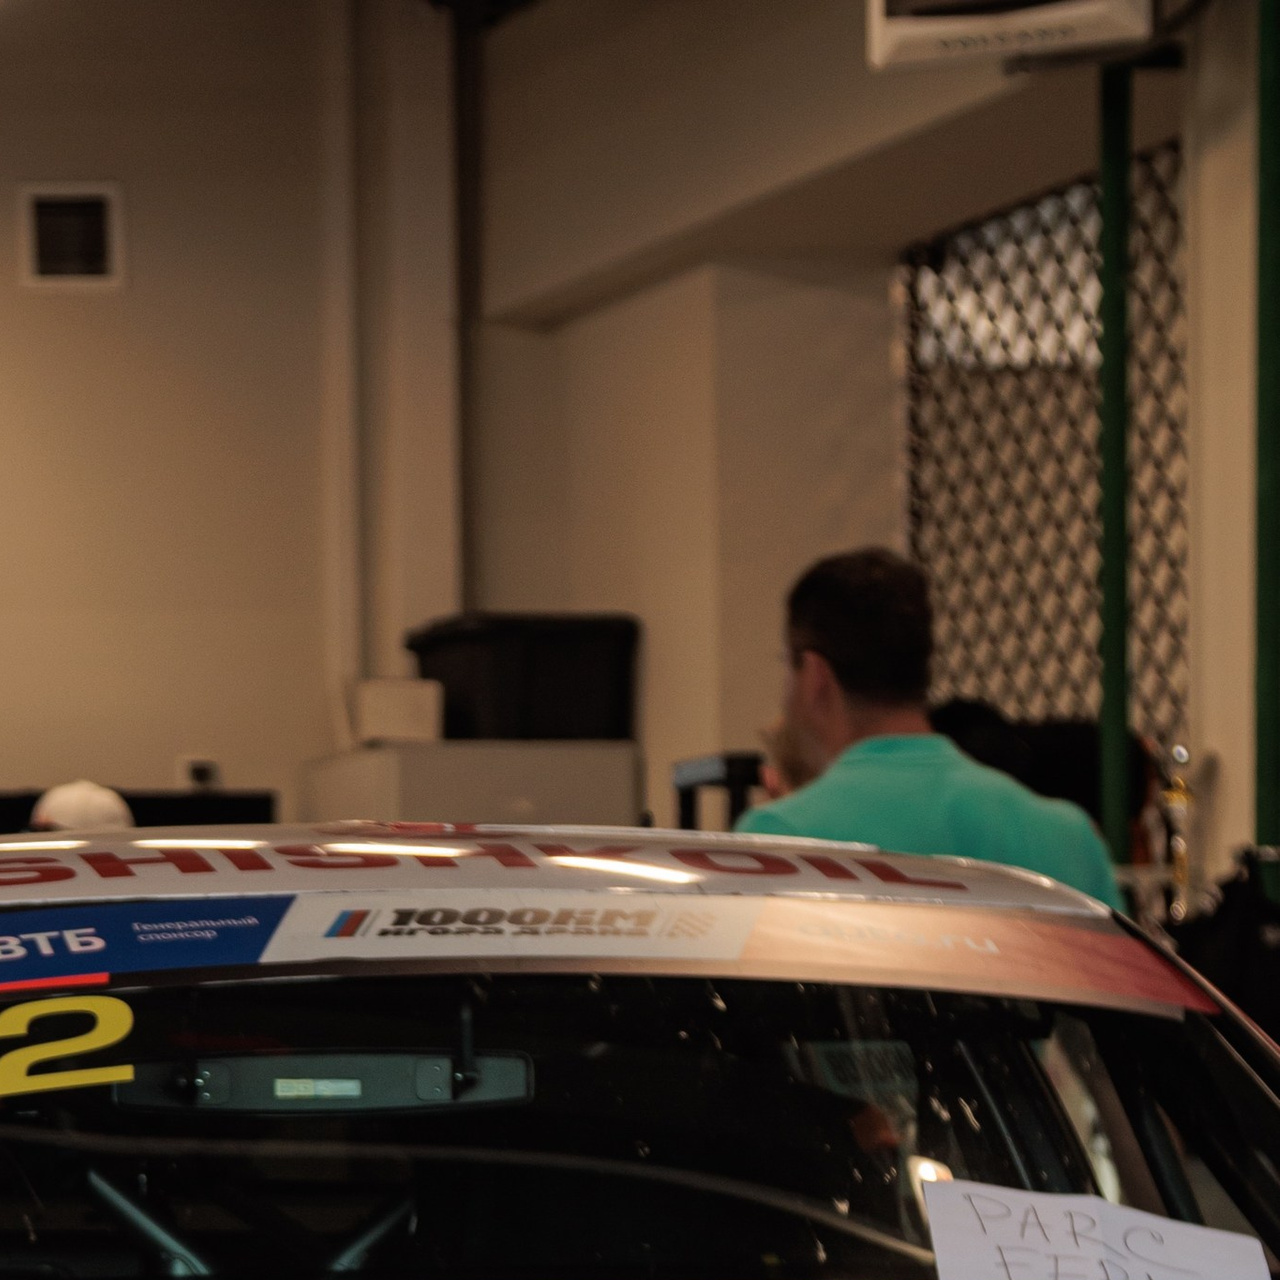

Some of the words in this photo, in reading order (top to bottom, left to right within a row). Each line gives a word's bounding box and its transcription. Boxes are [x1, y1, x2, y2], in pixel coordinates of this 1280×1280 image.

[131, 915, 260, 932] Генеральный
[136, 929, 218, 943] спонсор
[962, 1193, 1201, 1277] PARC
